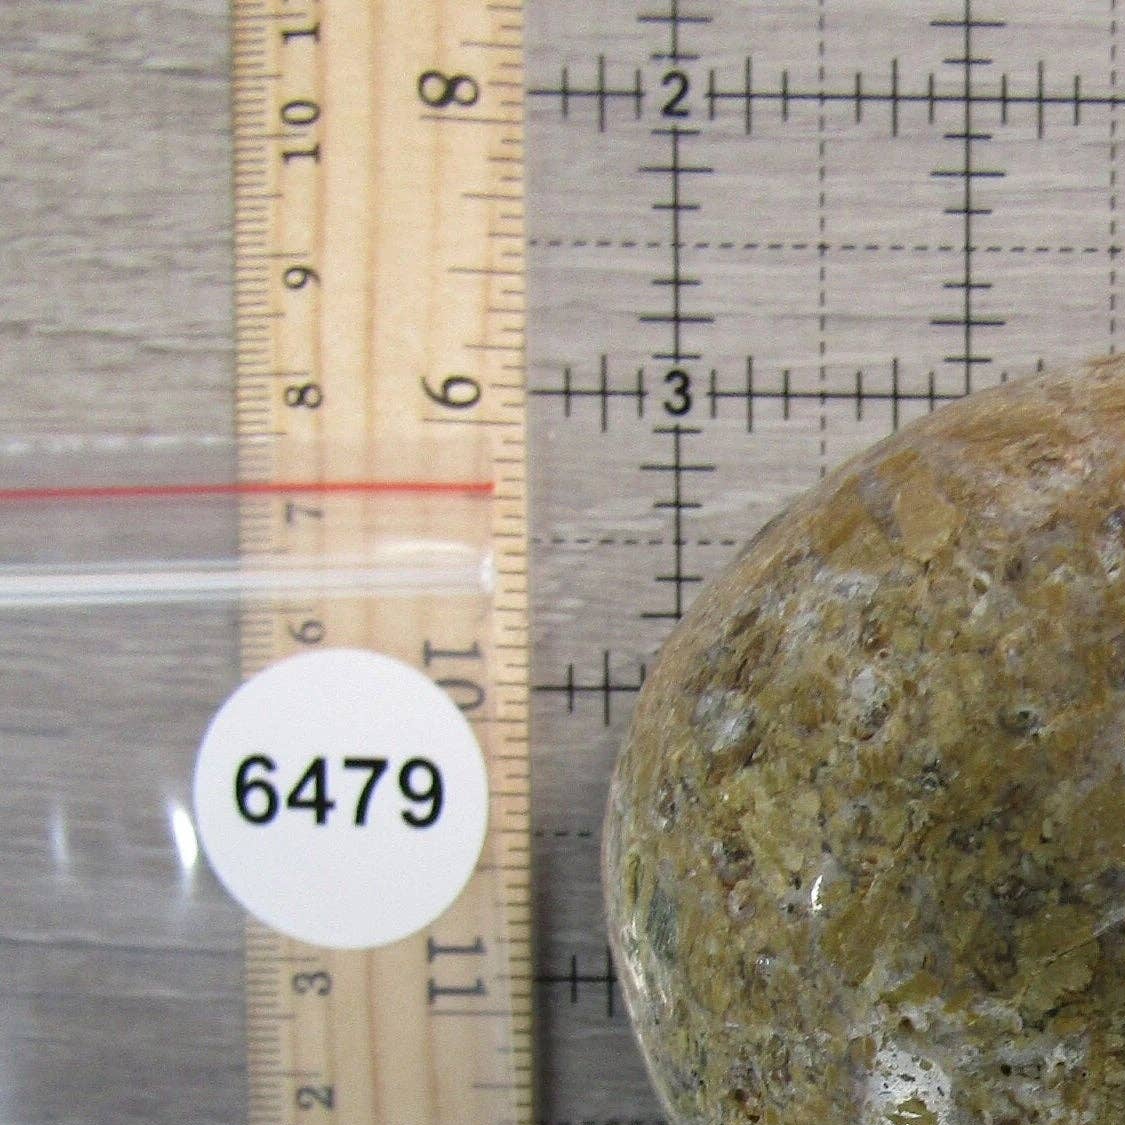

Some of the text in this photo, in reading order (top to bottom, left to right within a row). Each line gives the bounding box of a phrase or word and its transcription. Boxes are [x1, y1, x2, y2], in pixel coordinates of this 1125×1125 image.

[418, 69, 480, 109] 8
[661, 71, 691, 118] 2
[280, 98, 321, 167] 10
[282, 265, 321, 290] 9
[284, 382, 323, 409] 8
[418, 374, 482, 409] 9
[663, 369, 692, 417] 3
[285, 503, 325, 526] 7
[286, 618, 326, 645] 6
[233, 754, 445, 830] 6479
[292, 970, 332, 996] 3
[426, 936, 486, 1003] 11
[295, 1083, 335, 1111] 2
